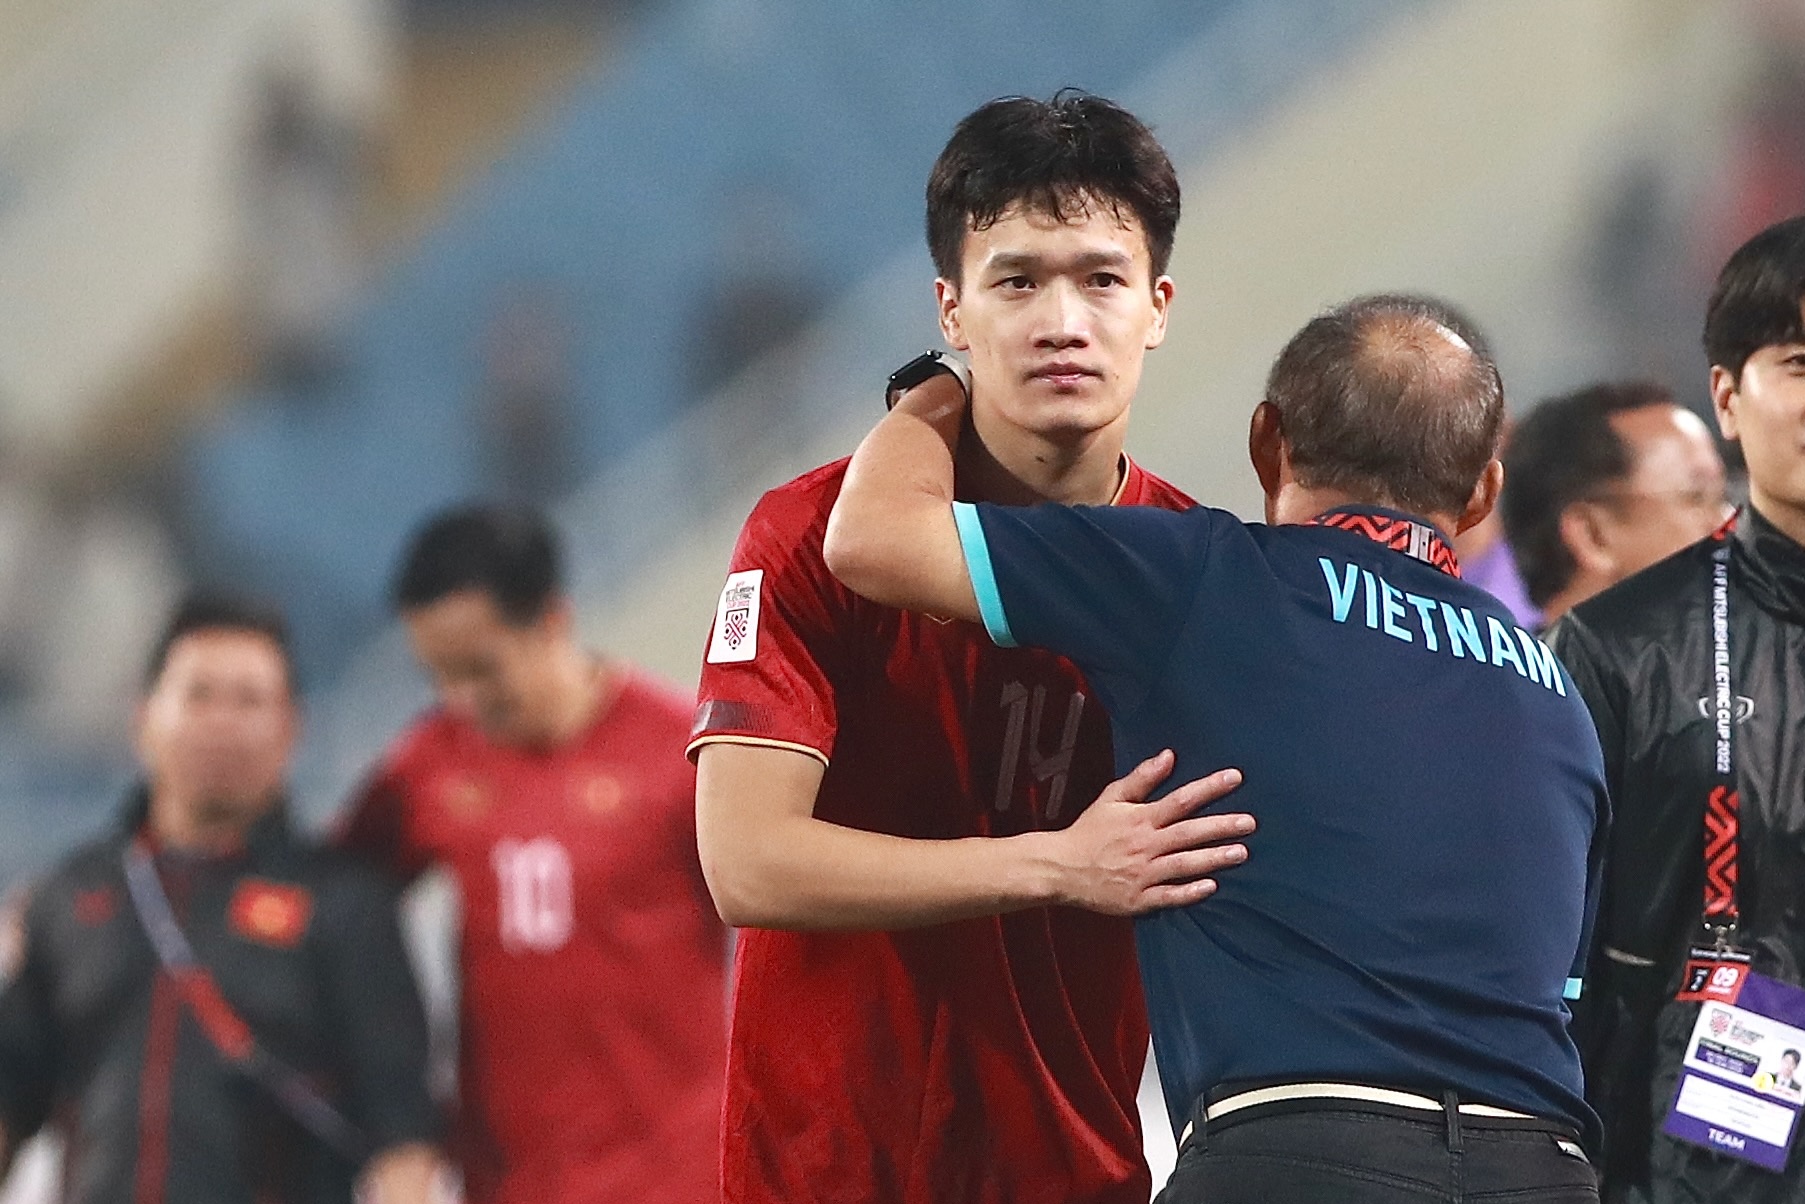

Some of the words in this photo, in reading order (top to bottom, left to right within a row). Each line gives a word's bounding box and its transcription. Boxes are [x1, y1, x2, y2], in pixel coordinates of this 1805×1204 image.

[1317, 556, 1567, 698] VIETNAM
[1714, 651, 1731, 709] ELECTRIC
[1716, 709, 1731, 740] CUP
[996, 680, 1085, 820] 14
[1716, 740, 1730, 774] 2022
[1708, 1128, 1746, 1151] TEAM
